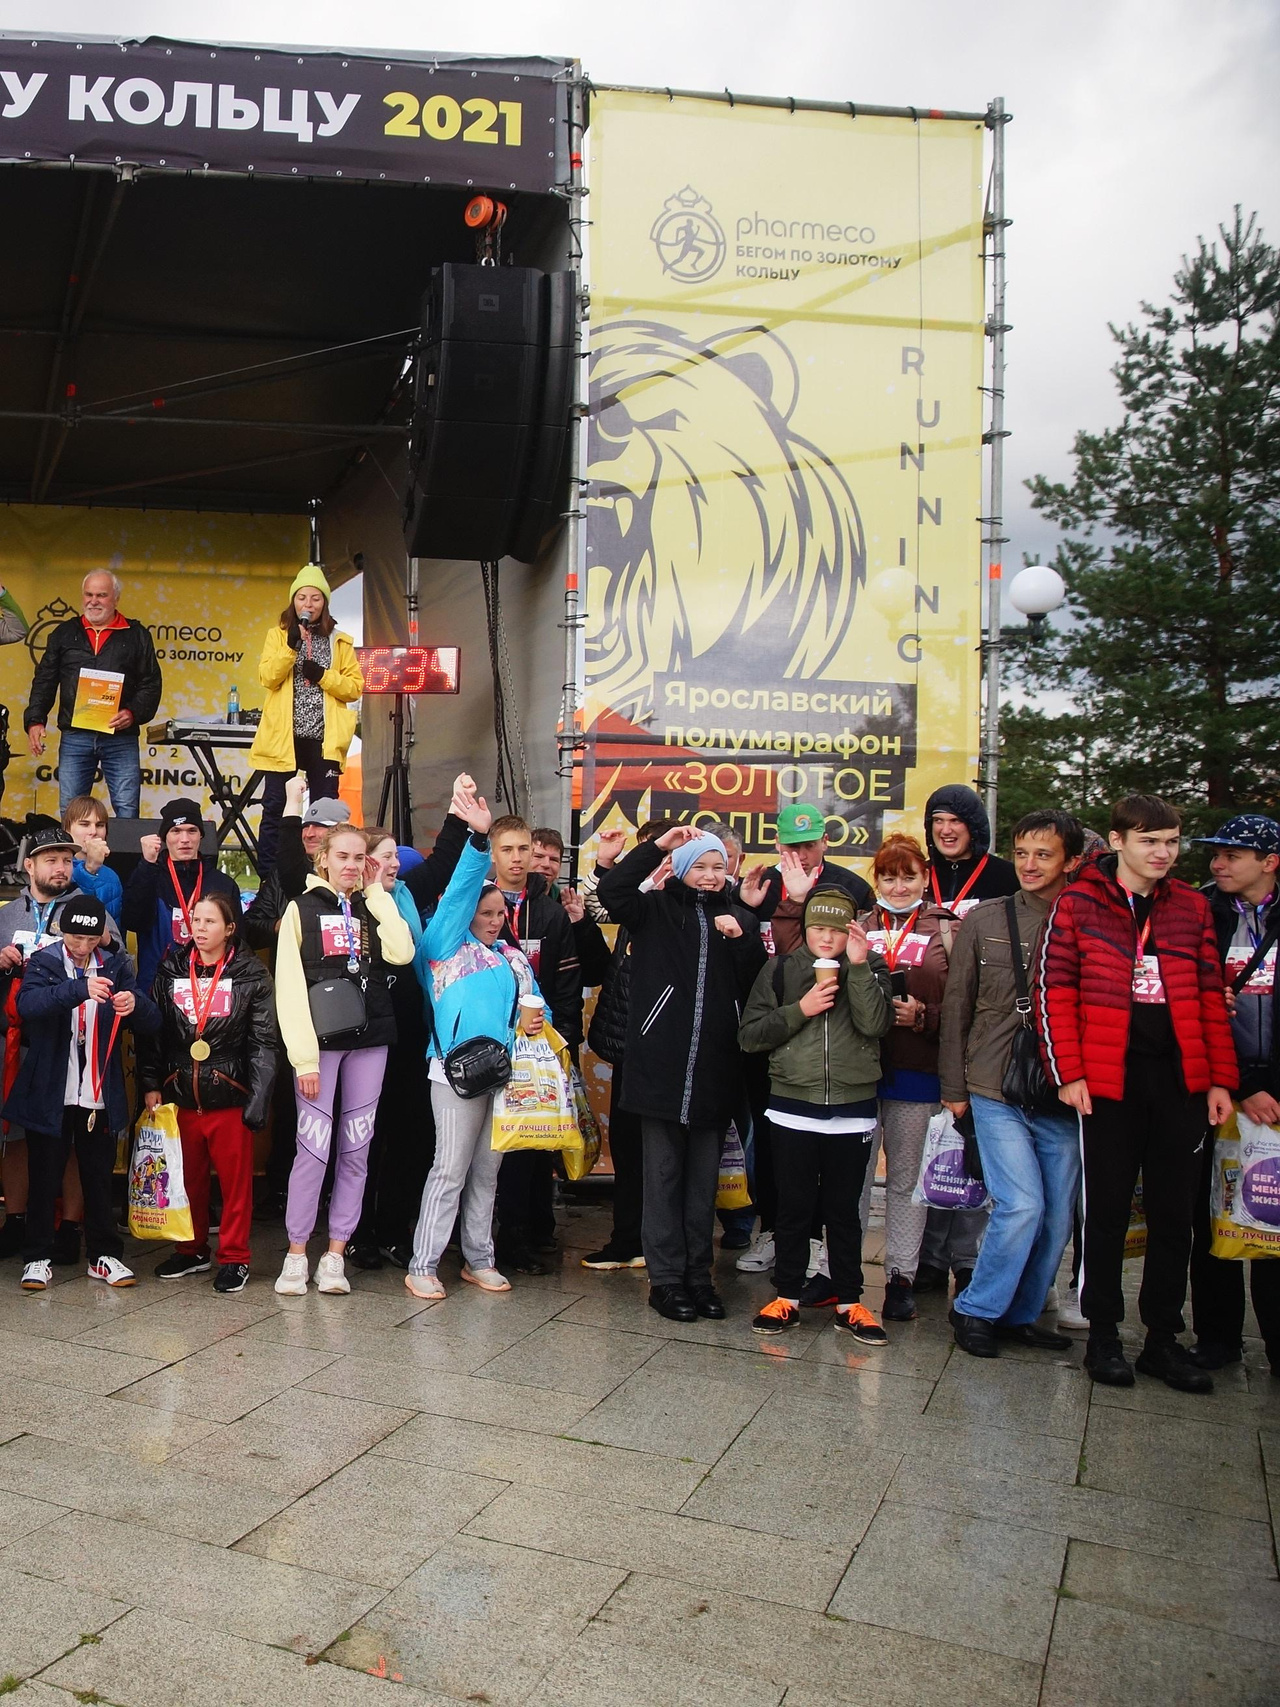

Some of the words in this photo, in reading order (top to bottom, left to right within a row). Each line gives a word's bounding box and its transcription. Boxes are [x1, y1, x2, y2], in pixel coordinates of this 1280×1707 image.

[67, 74, 361, 143] КОЛЬЦУ
[383, 91, 522, 146] 2021
[736, 211, 876, 245] pharmeco
[735, 245, 786, 261] БЕГОМ
[790, 249, 813, 263] ПО
[817, 251, 902, 269] ЗОЛОТОМУ
[735, 266, 800, 281] КОЛЬЦУ
[169, 650, 244, 662] ЗОЛОТОМУ
[664, 680, 893, 716] Ярославский
[664, 725, 901, 759] полумарафон
[663, 761, 892, 801] «ЗОЛОТОЕ
[811, 905, 847, 917] UTILITY
[71, 914, 99, 925] JUDO
[1132, 980, 1163, 995] 27
[934, 1163, 954, 1174] БЕГ,
[1252, 1173, 1277, 1184] БЕГ,
[930, 1183, 965, 1195] ЖИЗНЬ
[1217, 1228, 1237, 1238] ВСЕ
